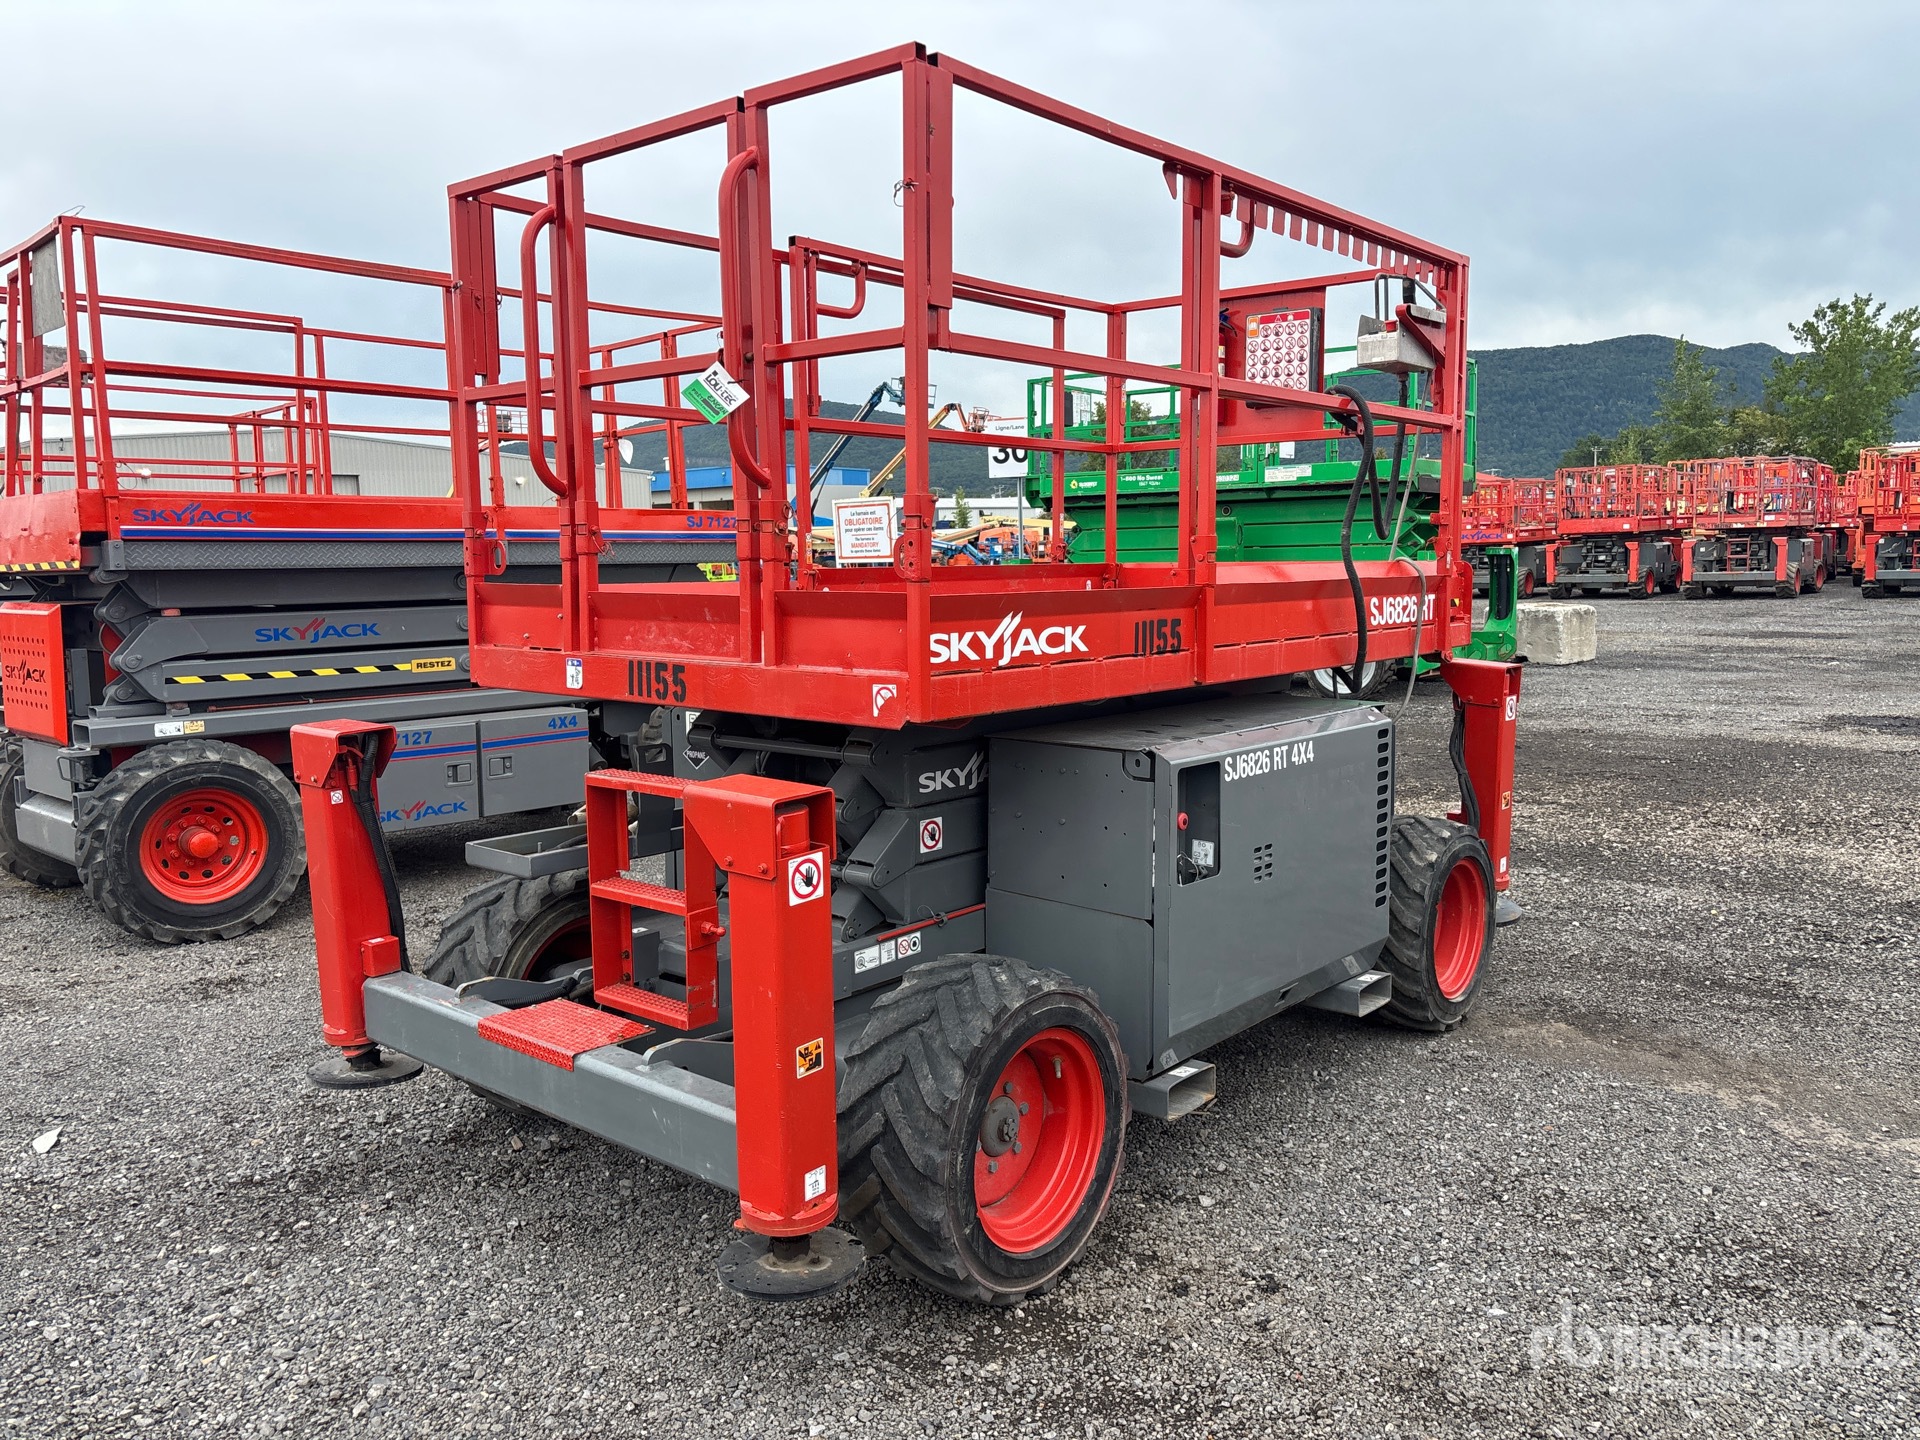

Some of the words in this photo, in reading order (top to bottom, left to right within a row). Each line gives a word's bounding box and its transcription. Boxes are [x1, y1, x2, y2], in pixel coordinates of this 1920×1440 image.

[992, 447, 1028, 464] 30
[132, 502, 255, 526] SKYJACK
[686, 515, 703, 528] SJ
[707, 516, 737, 529] 7127
[844, 517, 883, 526] OBLIGATOIRE
[1460, 530, 1503, 541] KYJACK
[1370, 595, 1418, 626] SJ6826
[254, 617, 381, 643] SKYJACK
[930, 610, 1089, 666] SKYJACK
[5, 659, 47, 685] SKYJACK
[416, 659, 453, 670] RESTEZ
[547, 715, 579, 730] 4X4
[686, 750, 706, 760] PROPANE
[1224, 749, 1271, 782] SJ6826
[1273, 744, 1289, 771] RT
[1291, 740, 1315, 766] 4X4
